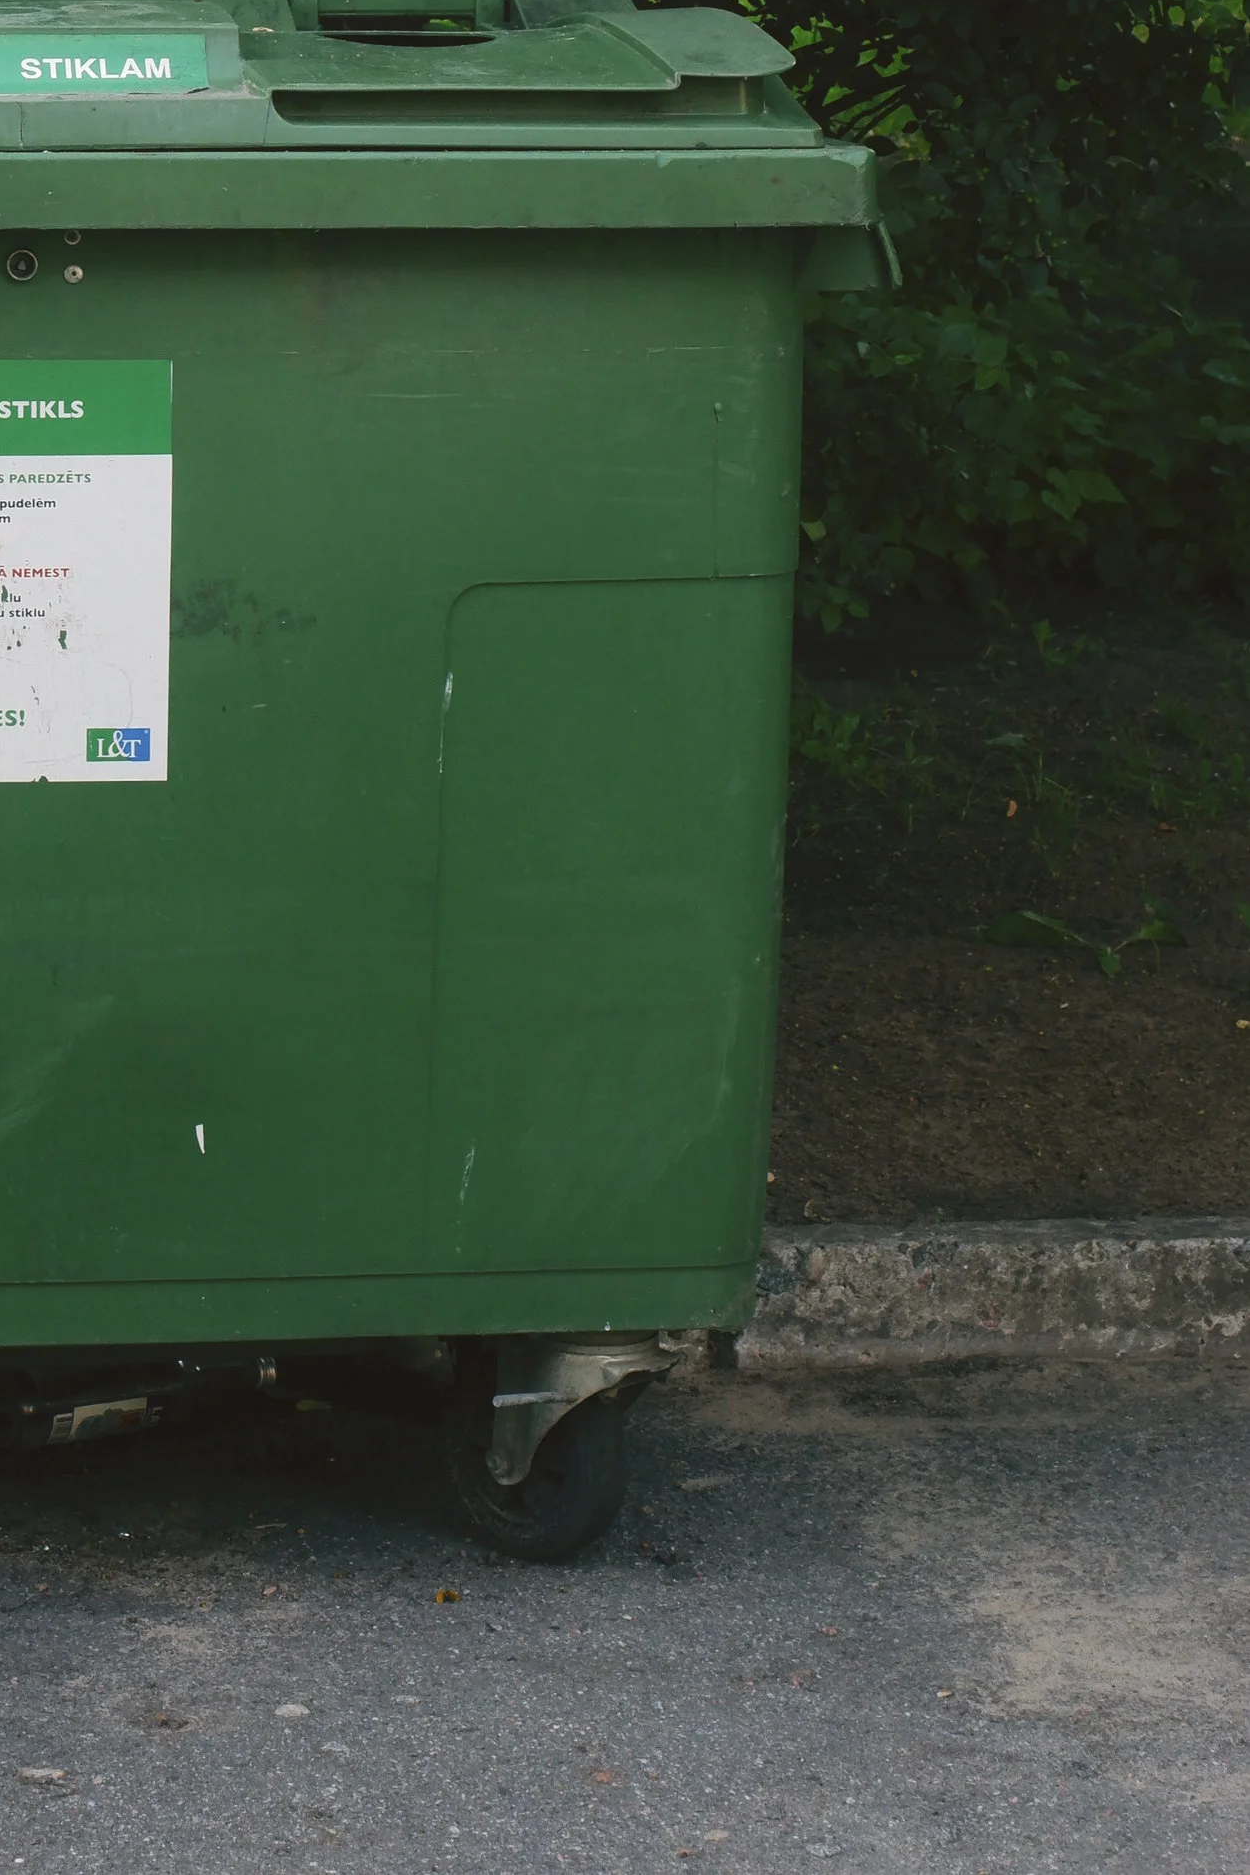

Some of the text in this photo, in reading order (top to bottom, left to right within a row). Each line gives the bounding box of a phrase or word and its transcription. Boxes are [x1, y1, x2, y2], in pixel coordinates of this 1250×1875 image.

[20, 57, 171, 80] STIKLAM
[9, 470, 92, 485] PAREDZĒTS
[0, 497, 56, 511] pudelēm
[12, 568, 70, 578] NEMEST
[9, 607, 46, 618] stiklu
[96, 730, 142, 758] L&T
